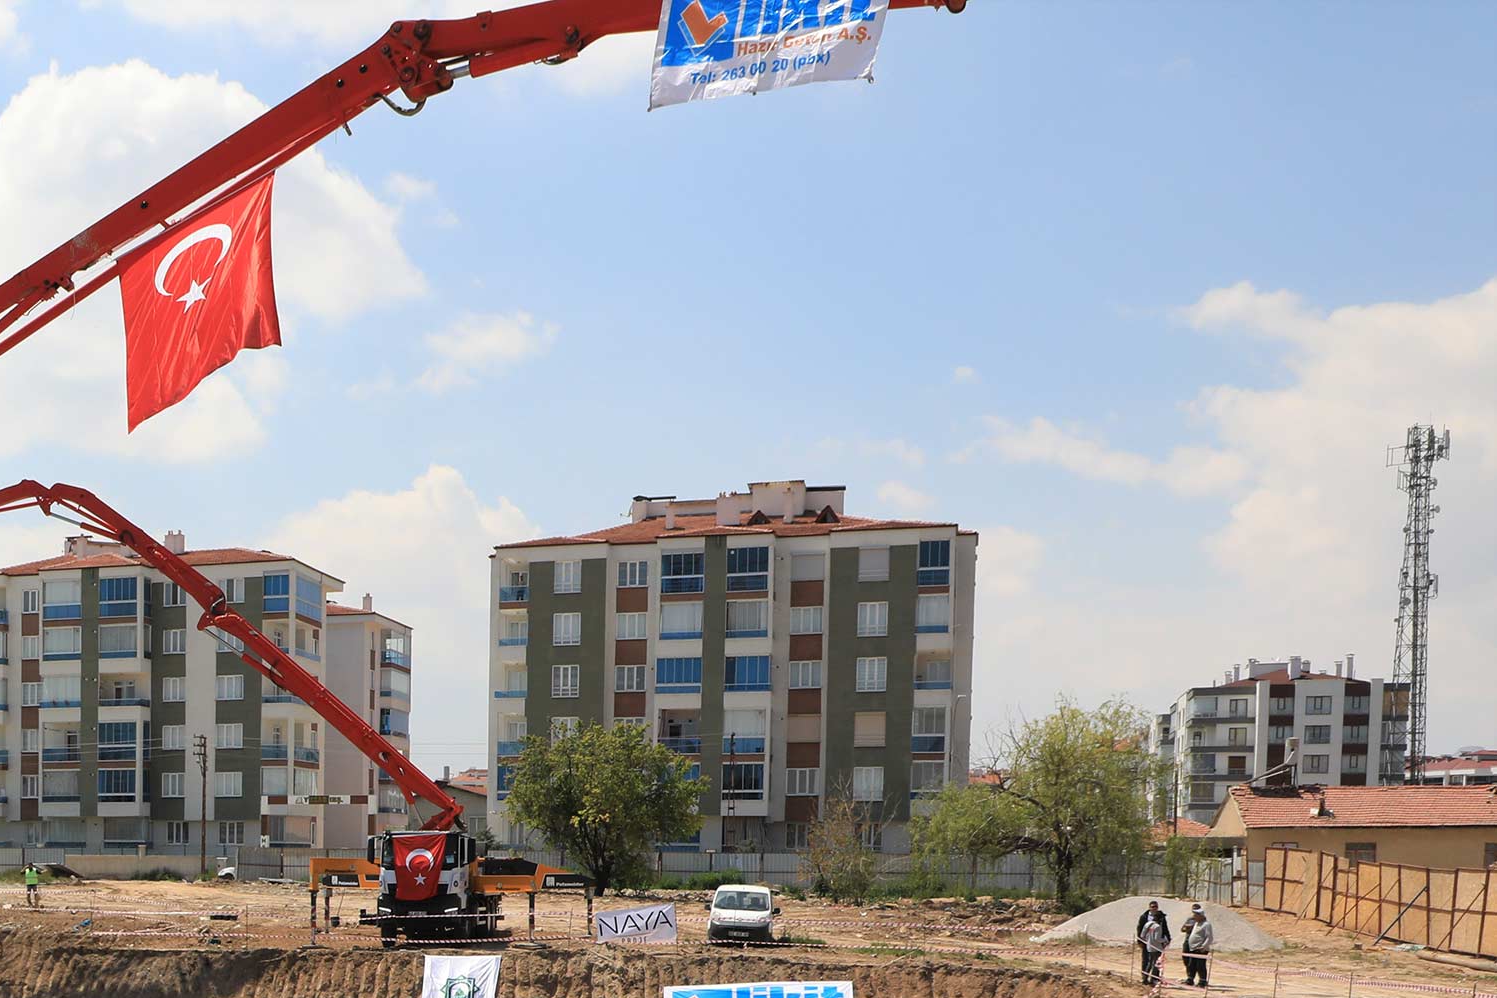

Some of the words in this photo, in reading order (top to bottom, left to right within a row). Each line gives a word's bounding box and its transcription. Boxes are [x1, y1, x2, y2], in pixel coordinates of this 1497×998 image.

[837, 26, 872, 45] A.Ş.
[690, 71, 717, 85] Tel:
[721, 65, 746, 81] 263
[749, 61, 767, 76] 00
[771, 58, 789, 73] 20
[793, 50, 831, 70] (pbx)
[598, 910, 673, 937] NAYA
